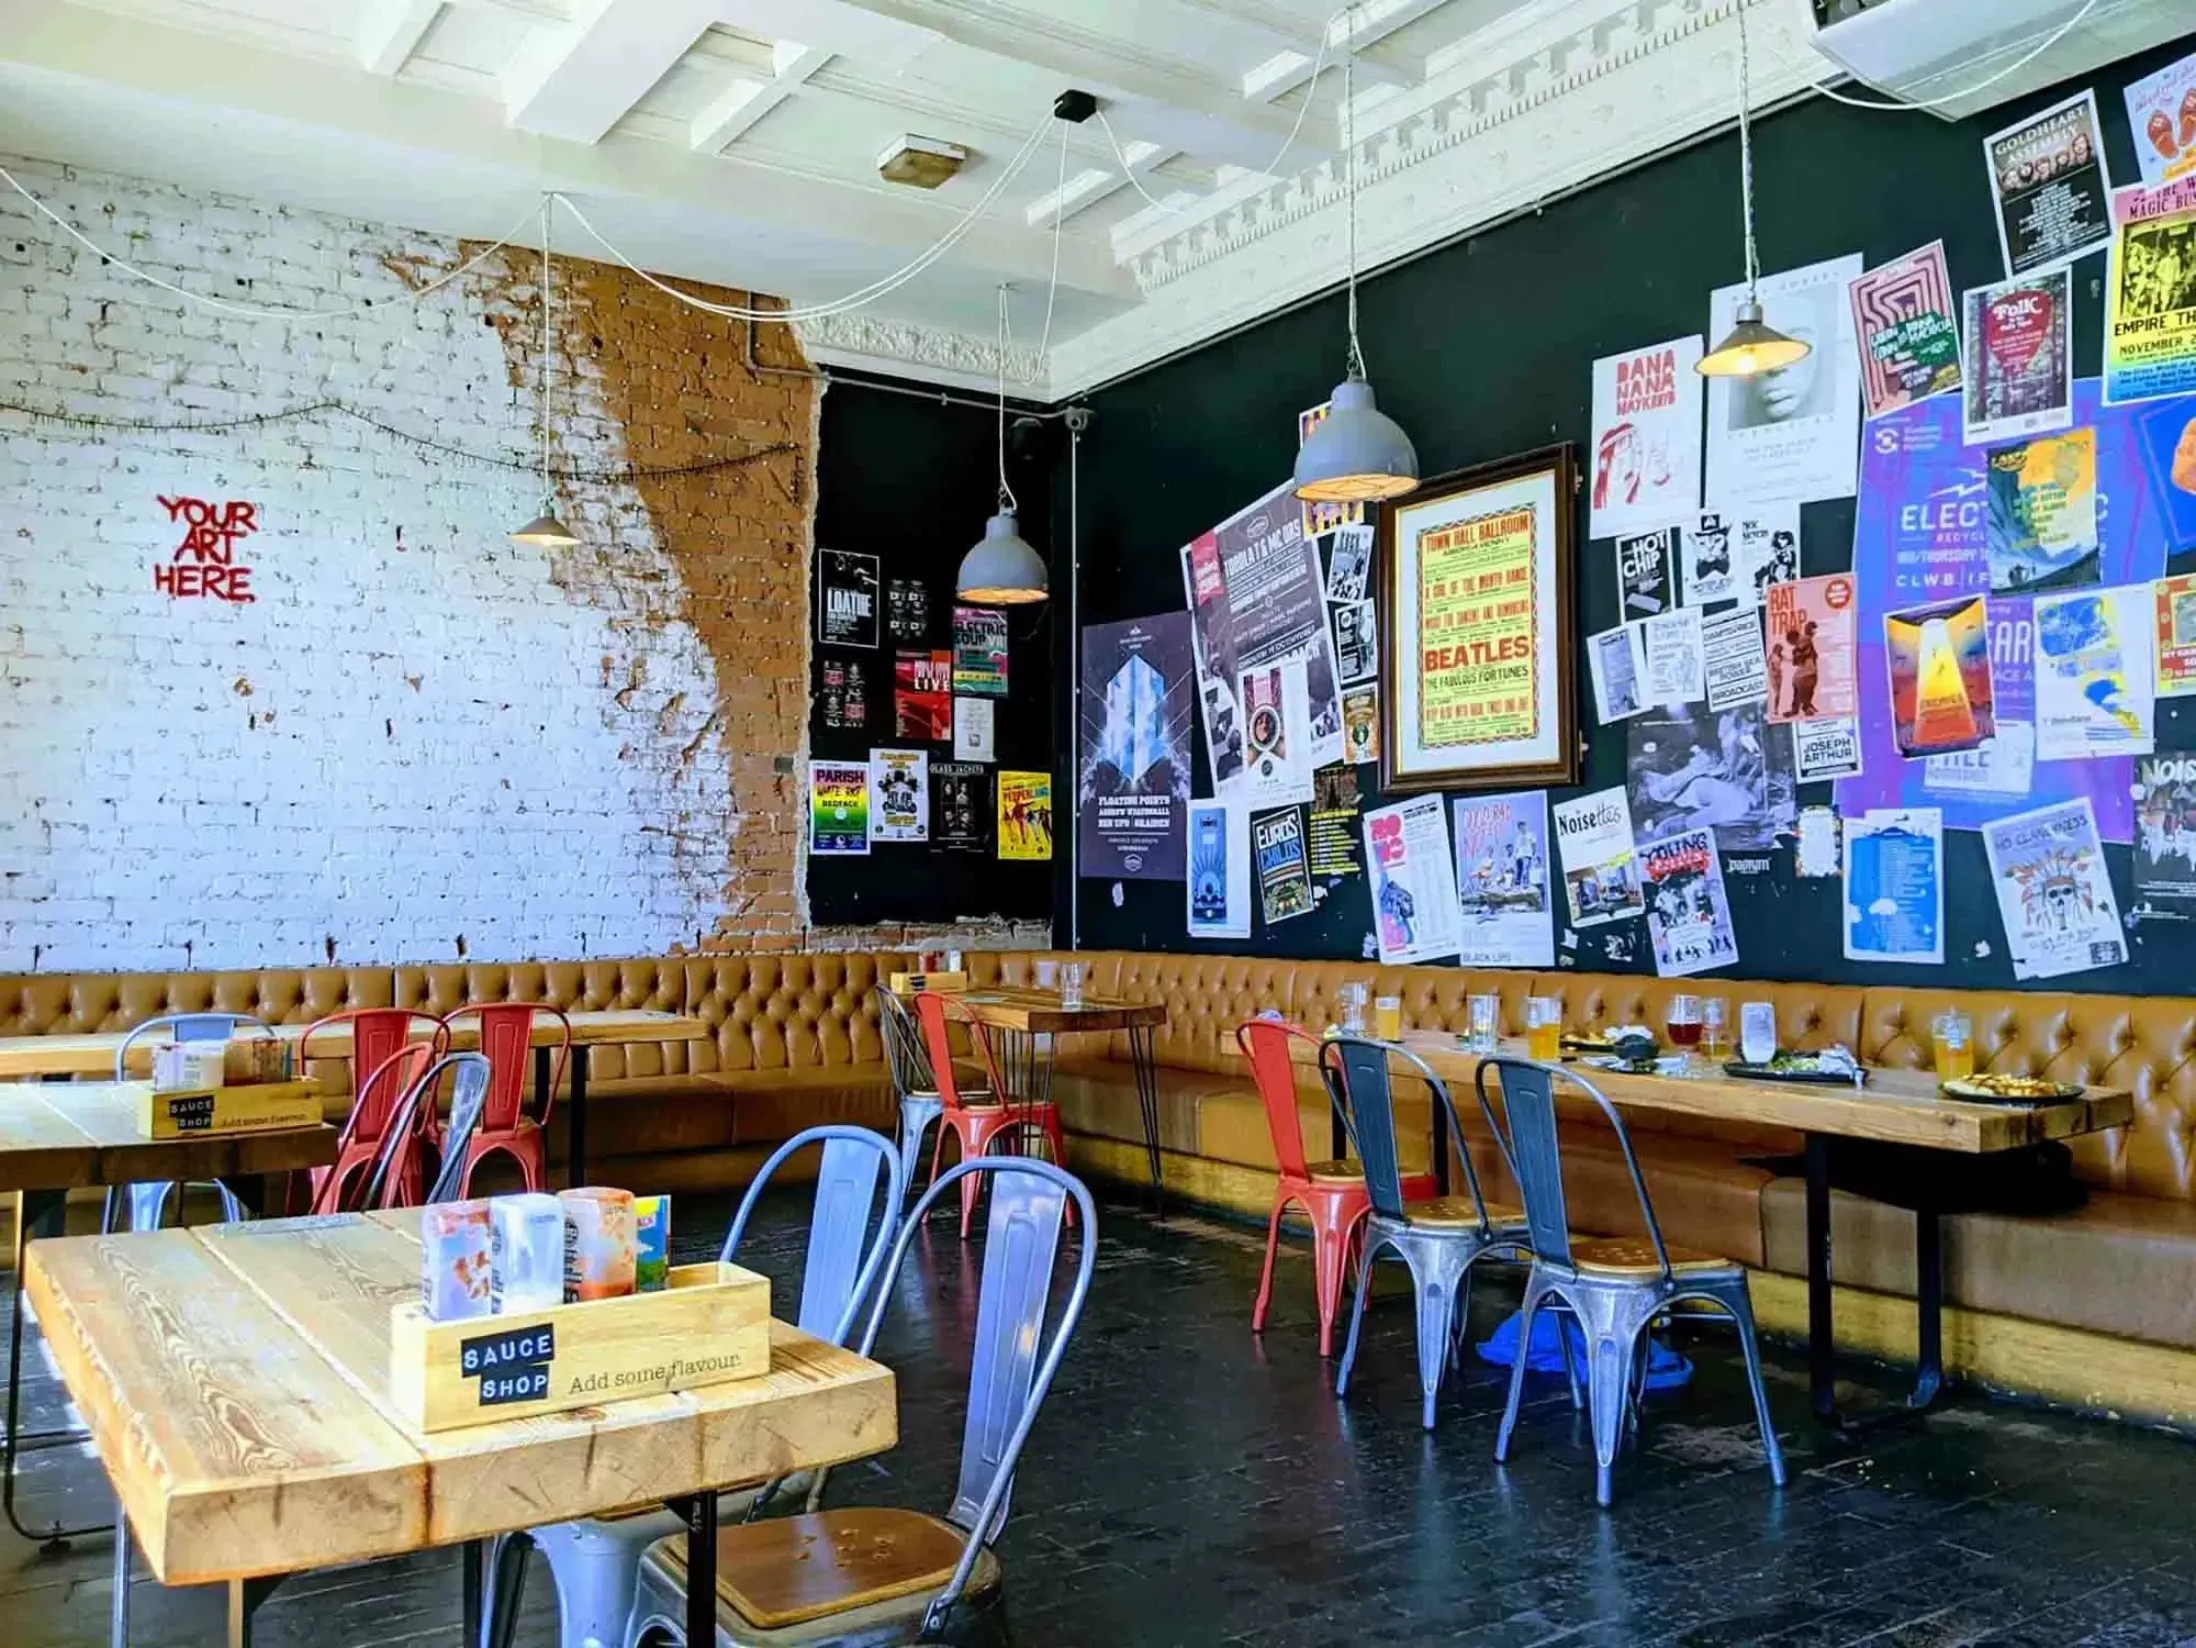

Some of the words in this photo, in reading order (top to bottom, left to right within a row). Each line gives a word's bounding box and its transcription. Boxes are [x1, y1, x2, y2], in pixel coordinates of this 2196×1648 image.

[1994, 104, 2085, 156] GOLDHEART
[2128, 196, 2169, 221] MAGIC
[2114, 314, 2168, 336] EMPIRE
[2119, 336, 2184, 357] NOVEMBER
[1616, 375, 1675, 400] NANA
[156, 494, 258, 532] YOUR
[173, 527, 247, 565] ART
[1426, 533, 1451, 553] TOWN
[1454, 527, 1475, 546] HALL
[1479, 514, 1529, 541] BALLROOM
[1633, 531, 1667, 555] HOT
[1623, 552, 1661, 578] CHIP
[154, 563, 256, 603] HERE
[1770, 587, 1796, 611] RAT
[1770, 609, 1808, 636] TRAP
[1425, 635, 1530, 673] BEATLES
[913, 680, 950, 692] LIVE
[1478, 665, 1529, 683] FORTUNES
[1804, 737, 1852, 754] JOSEPH
[1804, 748, 1852, 764] ARTHUR
[816, 769, 865, 784] PARISH
[1098, 796, 1138, 806] FLOATING
[1139, 795, 1171, 806] POINTS
[1255, 813, 1299, 849] EUROS
[1557, 801, 1622, 836] Noisettes
[1638, 832, 1708, 863] YOUNG
[170, 1100, 212, 1114] SAUCE
[179, 1117, 211, 1128] SHOP
[463, 1333, 553, 1371] SAUCE
[481, 1373, 548, 1400] SHOP
[569, 1372, 609, 1395] Add
[615, 1364, 666, 1388] some
